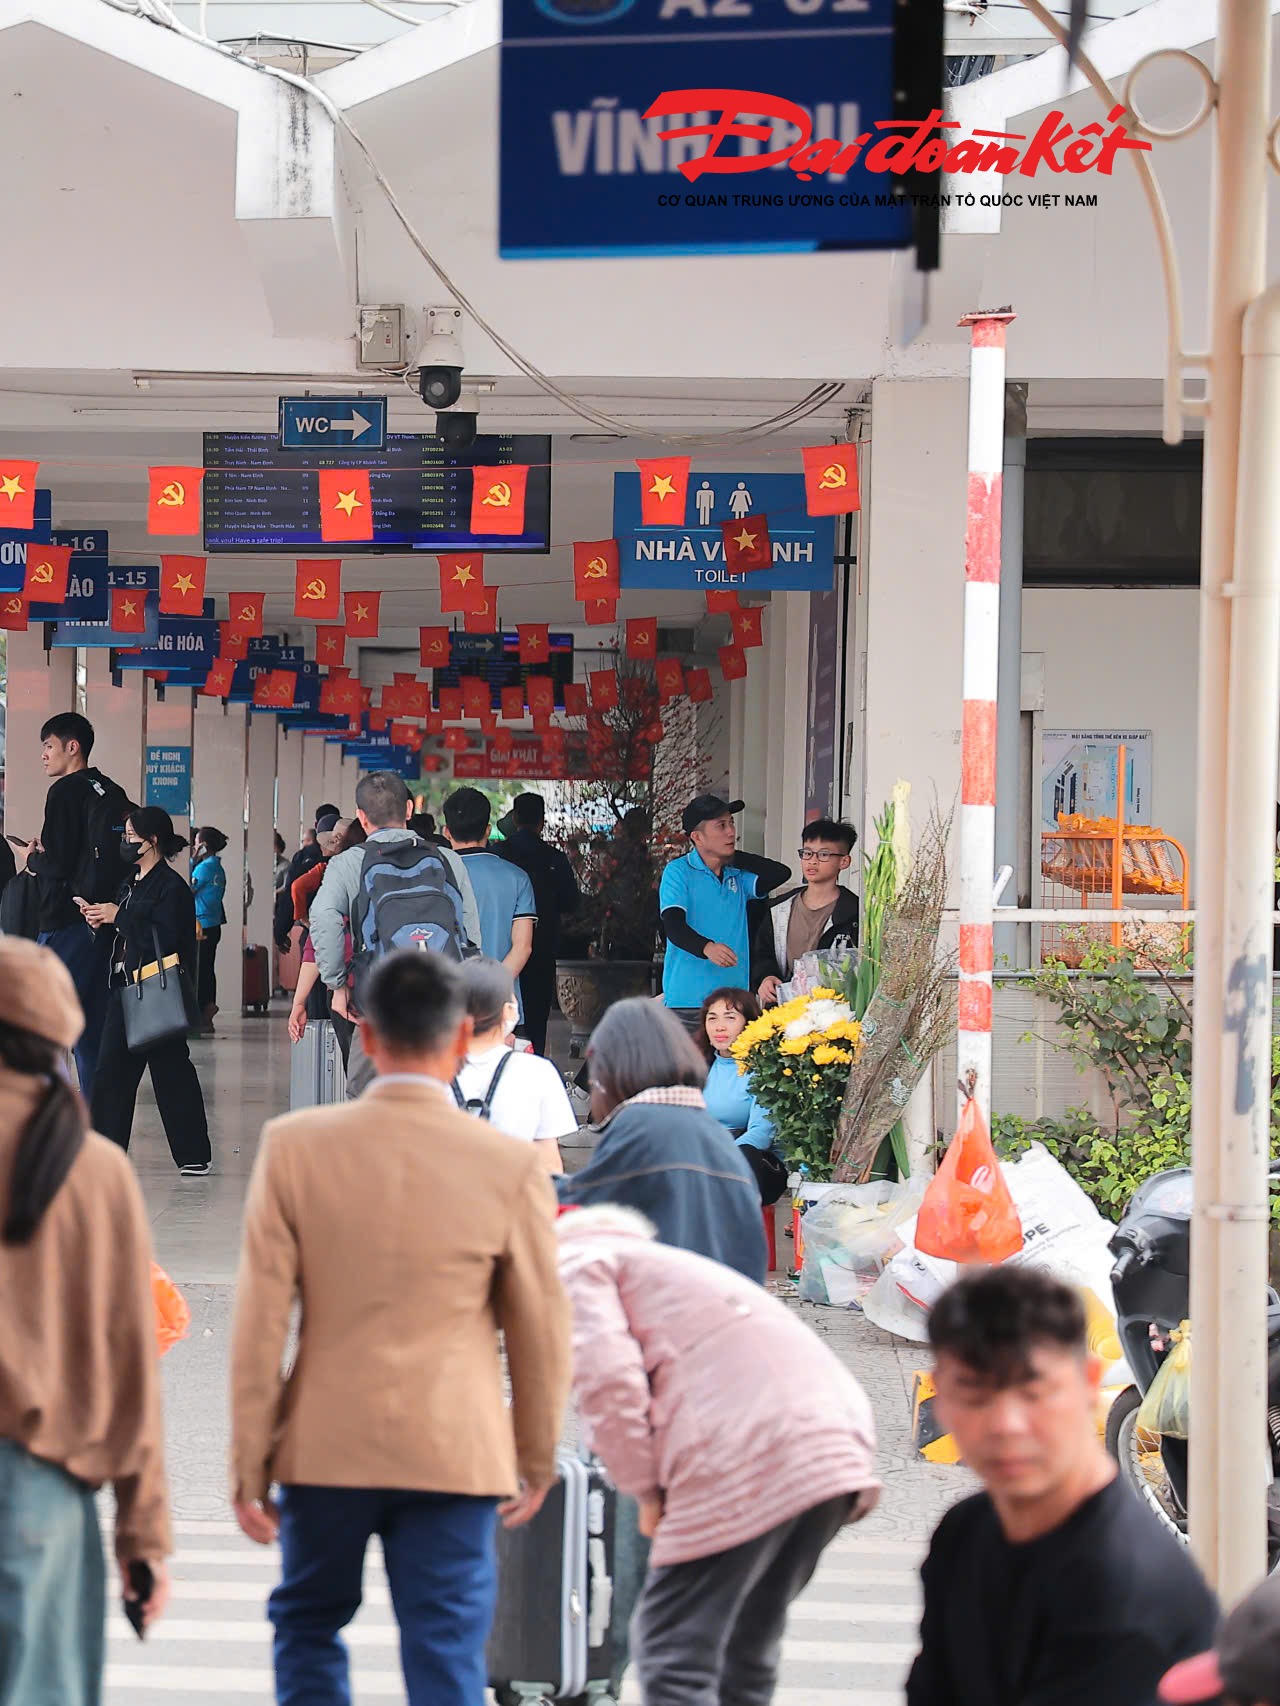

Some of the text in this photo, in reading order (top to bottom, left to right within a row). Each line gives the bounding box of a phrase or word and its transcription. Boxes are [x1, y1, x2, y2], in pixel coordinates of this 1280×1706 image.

[296, 417, 329, 434] WC
[635, 535, 696, 562] NHÀ
[176, 632, 205, 651] HÓA
[458, 640, 475, 649] WC
[162, 752, 181, 762] NGHỊ
[160, 762, 186, 774] KHÁCH
